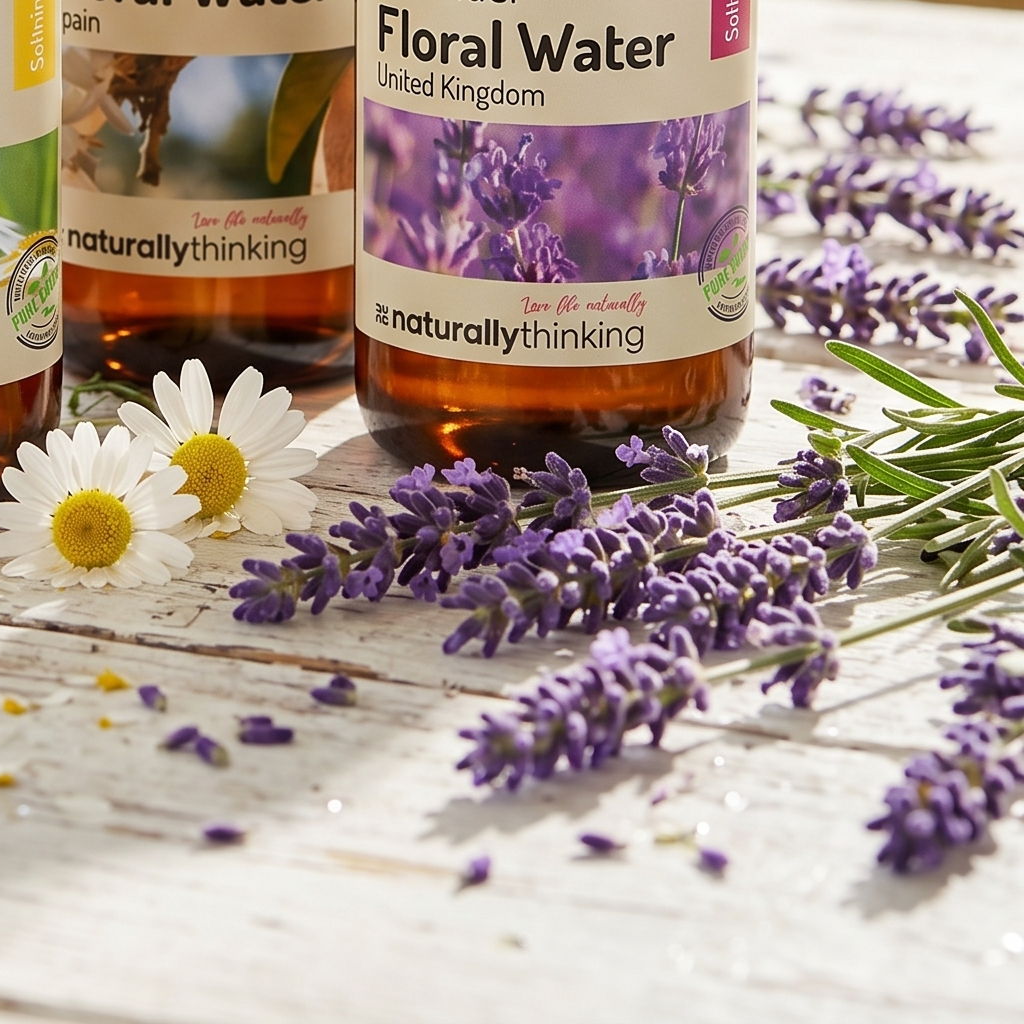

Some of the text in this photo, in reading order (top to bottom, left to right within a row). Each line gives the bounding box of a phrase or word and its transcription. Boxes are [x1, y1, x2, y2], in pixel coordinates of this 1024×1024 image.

[63, 9, 100, 34] pain
[378, 2, 675, 72] Floral Water
[378, 59, 544, 110] United Kingdom
[66, 224, 306, 267] naturallythinking
[392, 304, 645, 355] naturallythinking
